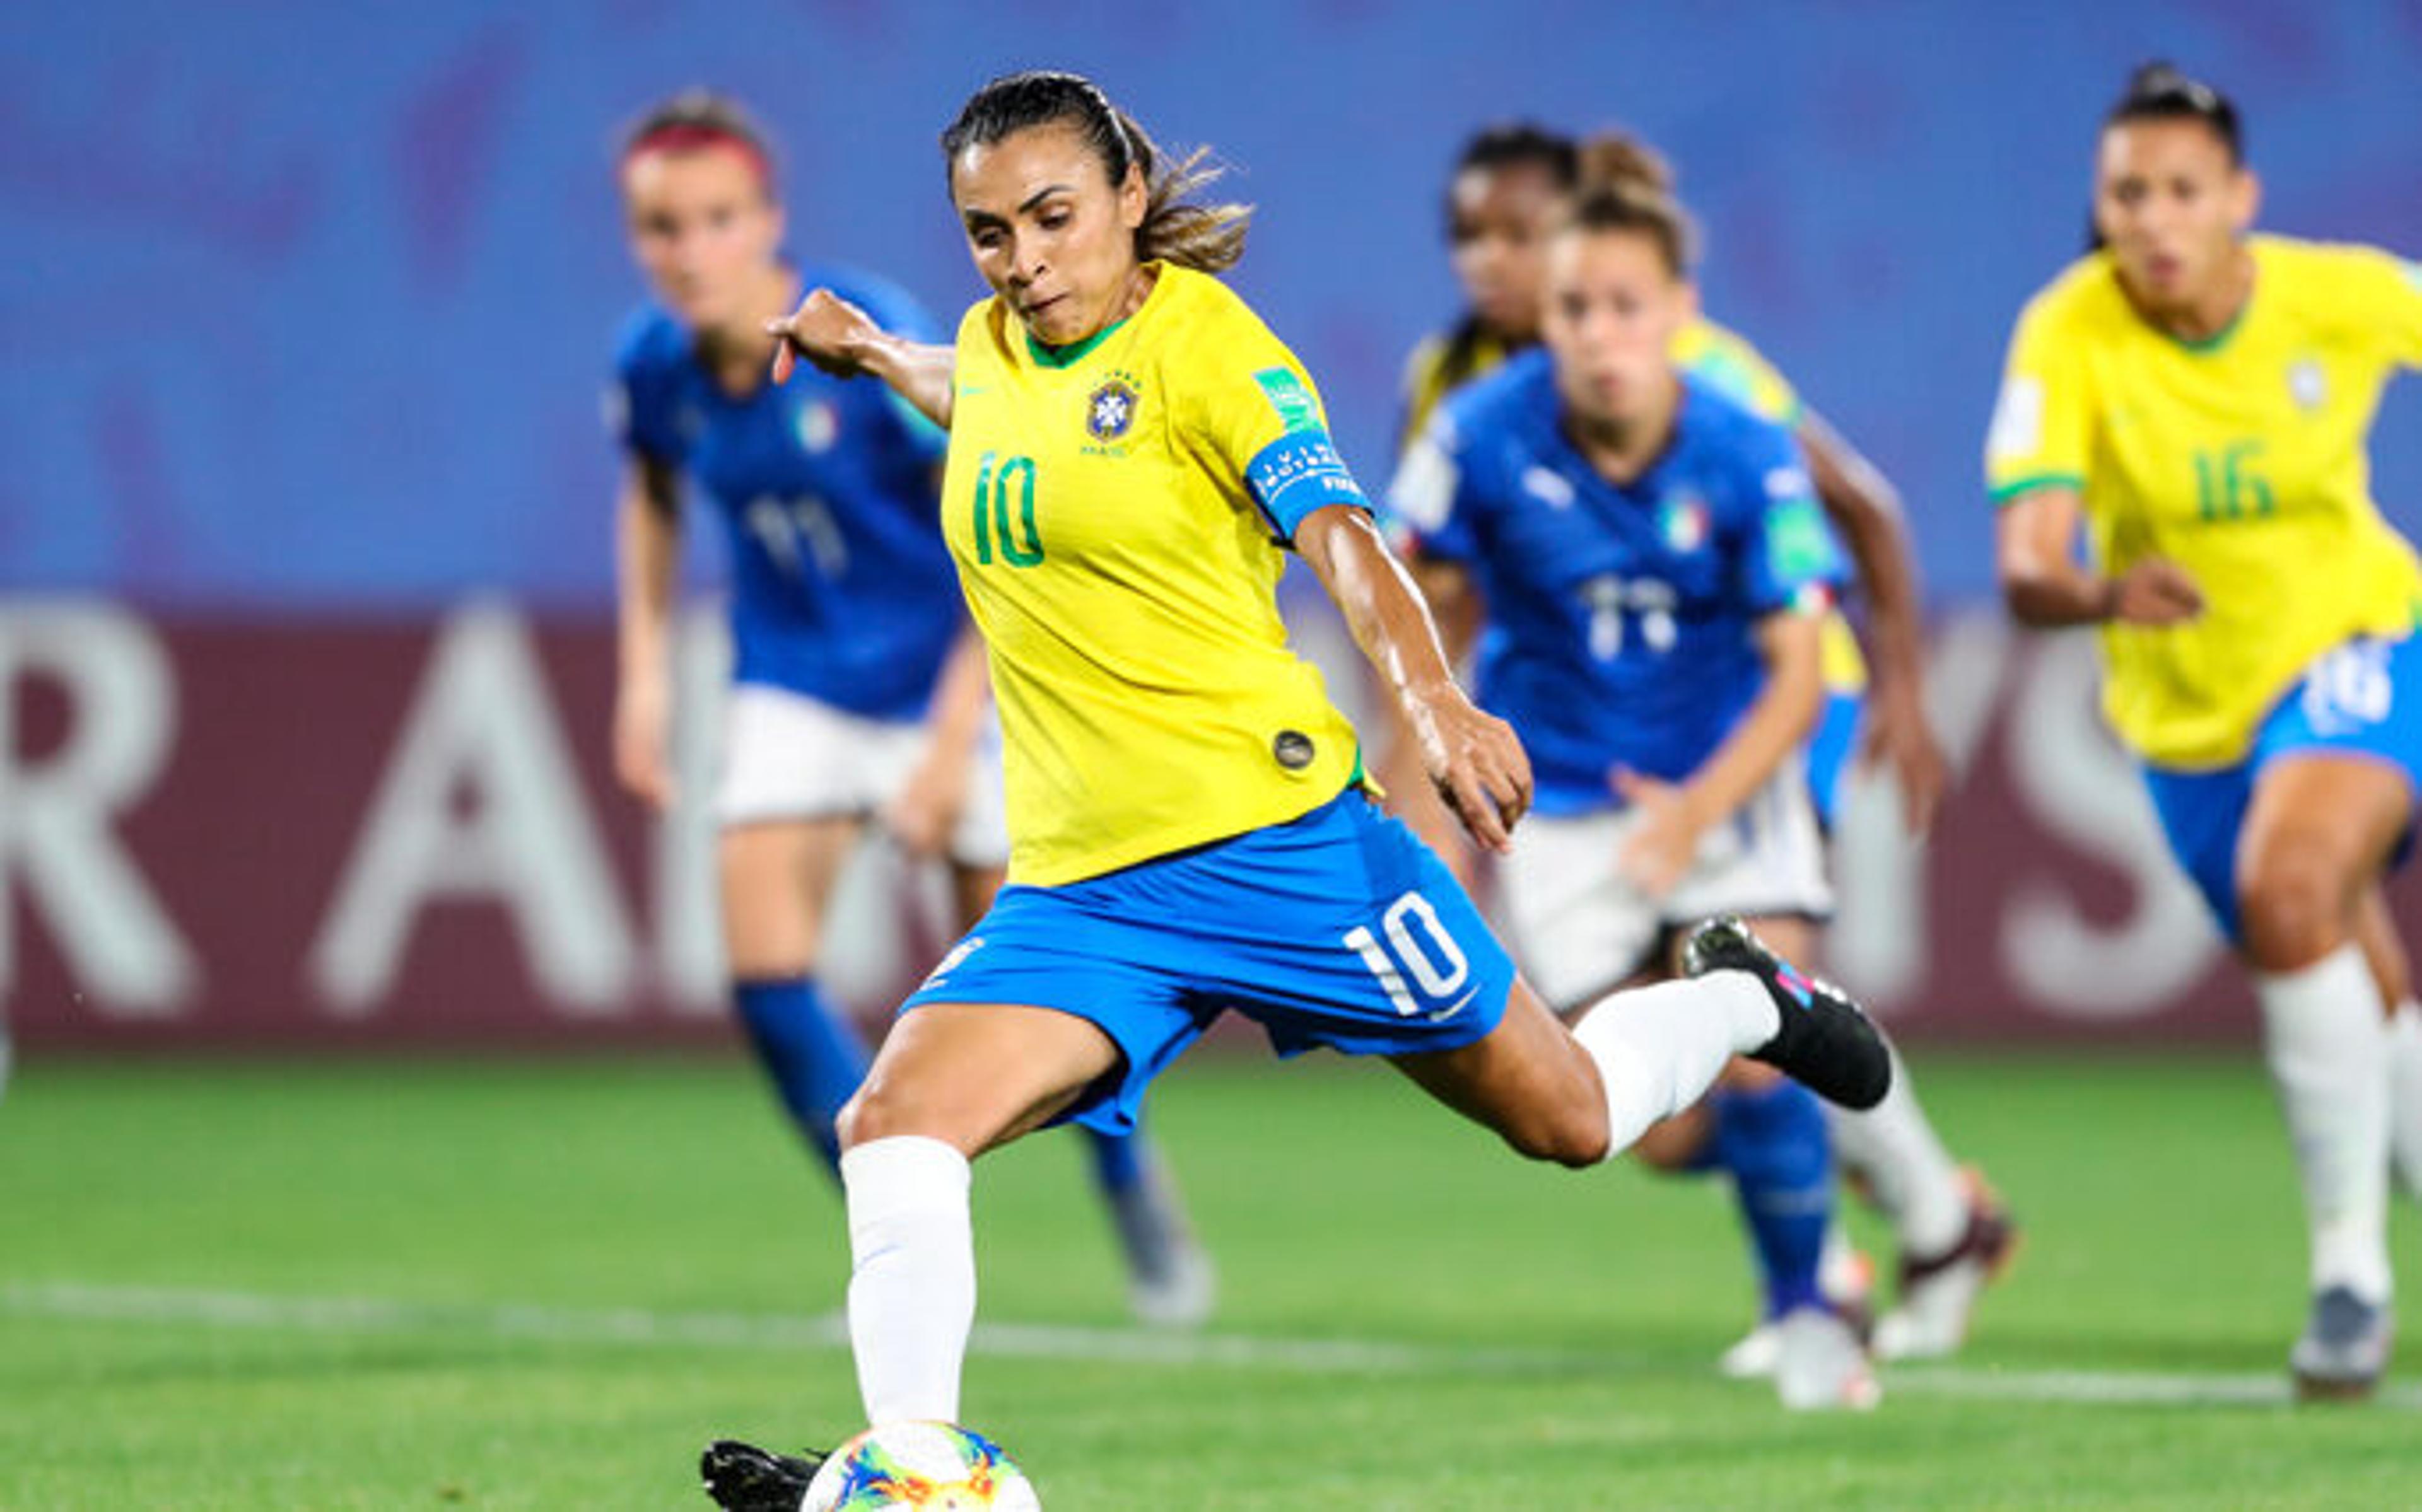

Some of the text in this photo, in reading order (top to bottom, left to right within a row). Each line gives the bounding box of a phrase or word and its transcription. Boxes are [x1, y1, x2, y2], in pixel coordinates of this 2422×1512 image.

[973, 451, 1044, 567] 10
[2193, 438, 2274, 525] 16
[1342, 891, 1468, 1016] 10
